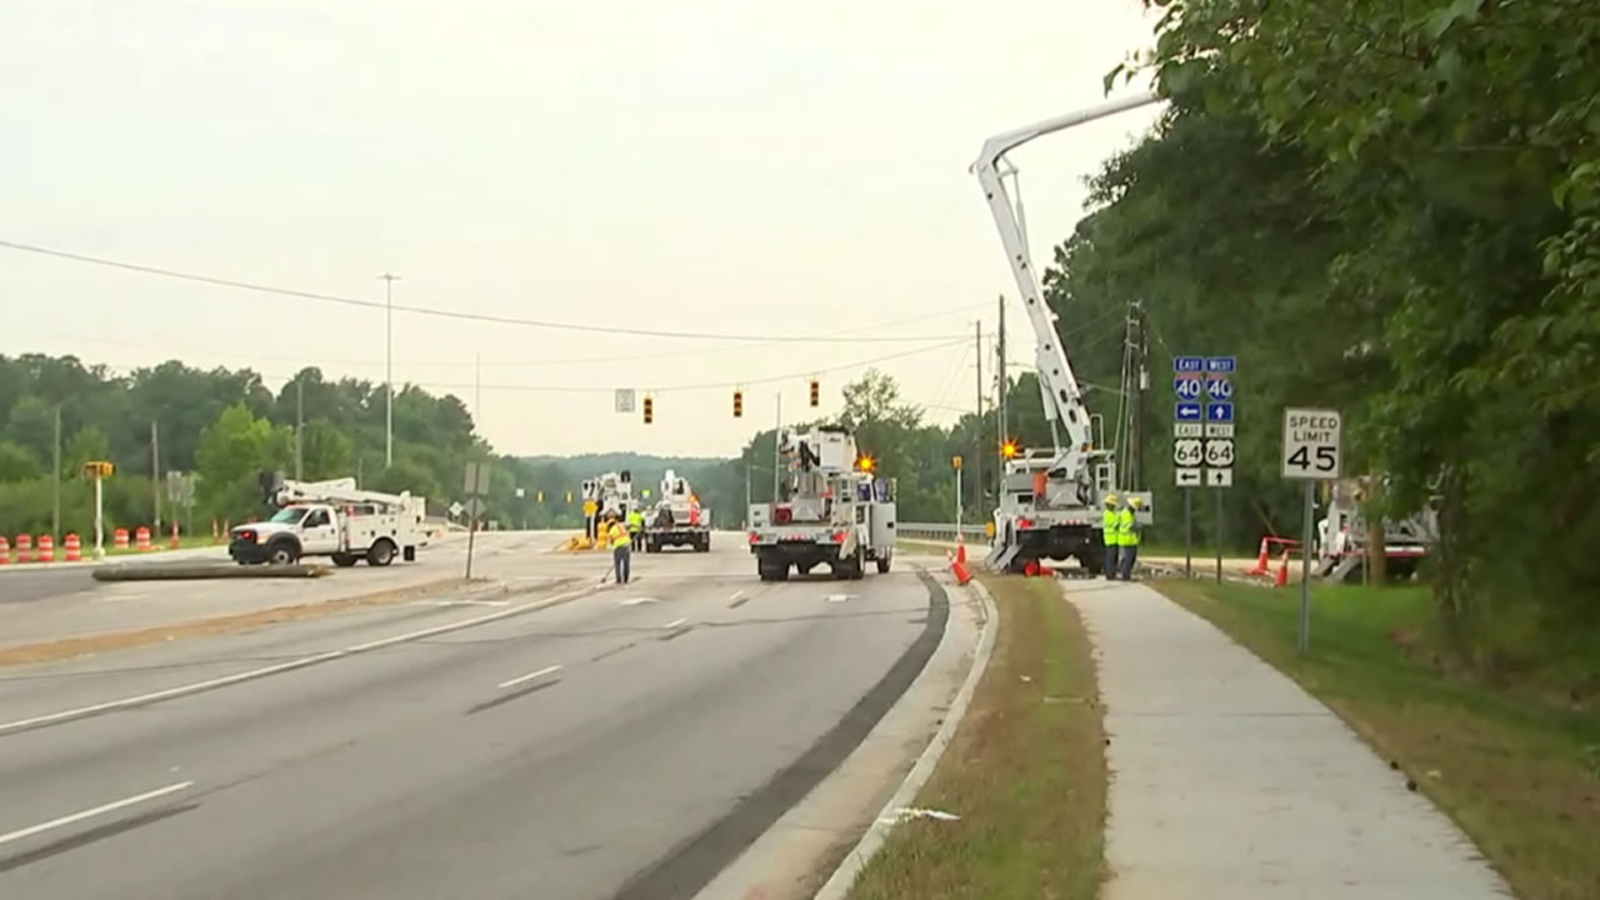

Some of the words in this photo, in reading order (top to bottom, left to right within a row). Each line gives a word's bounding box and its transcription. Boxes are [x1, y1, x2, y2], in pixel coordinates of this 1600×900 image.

[1178, 360, 1199, 370] EAST
[1210, 360, 1232, 370] WEST
[1177, 380, 1200, 395] 40
[1209, 380, 1232, 395] 40
[1290, 416, 1338, 429] SPEED
[1178, 426, 1199, 436] EAST
[1210, 426, 1232, 436] WEST
[1294, 432, 1331, 442] LIMIT
[1177, 446, 1199, 461] 64
[1208, 446, 1231, 461] 64
[1287, 446, 1337, 471] 45
